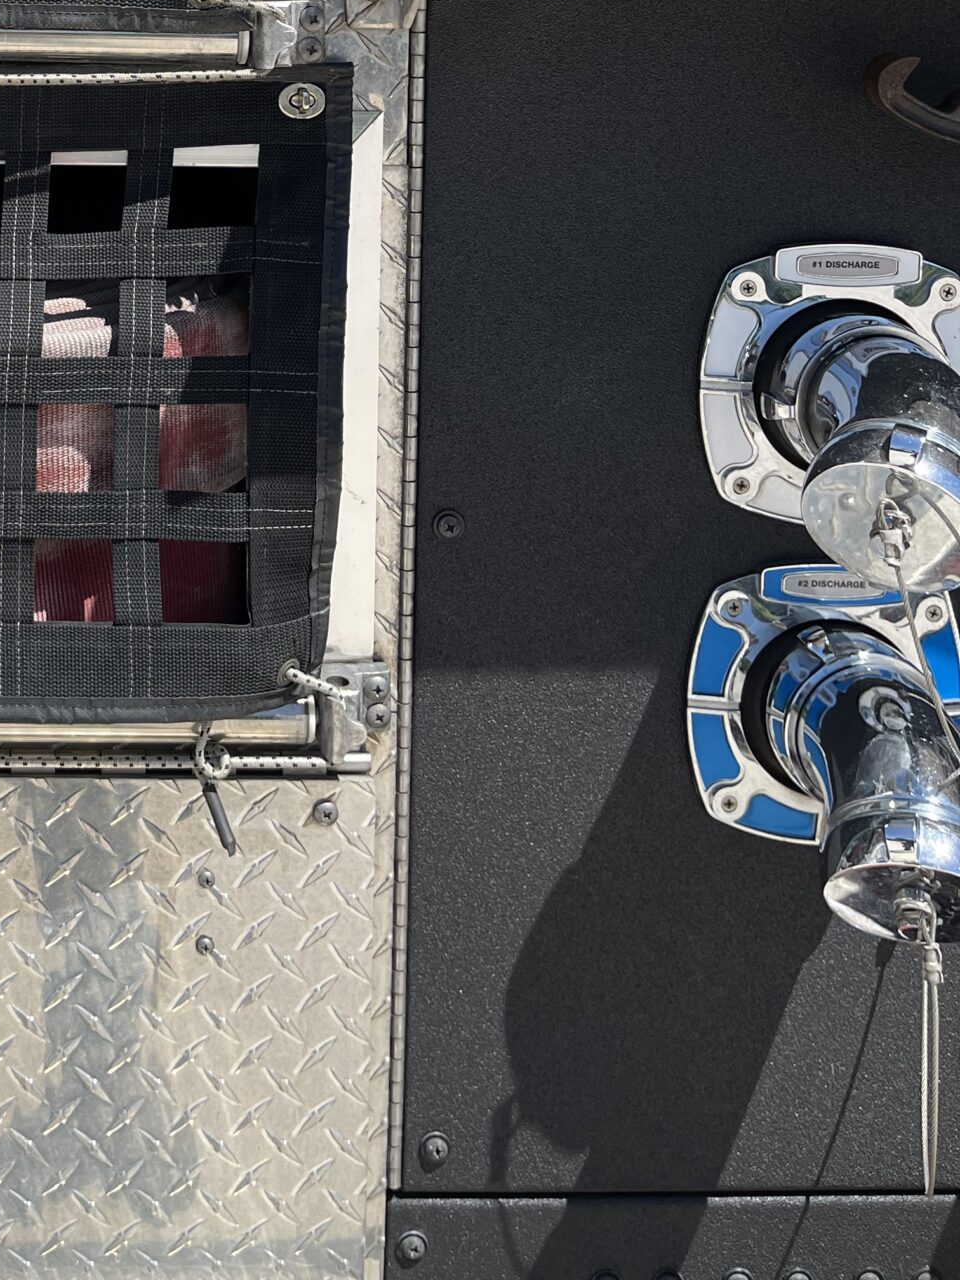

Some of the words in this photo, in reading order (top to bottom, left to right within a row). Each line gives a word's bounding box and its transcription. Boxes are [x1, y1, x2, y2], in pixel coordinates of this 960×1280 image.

[812, 260, 823, 269] #1
[825, 260, 880, 269] DISCHARGE
[798, 580, 808, 588] #2
[811, 579, 866, 589] DISCHARGE
